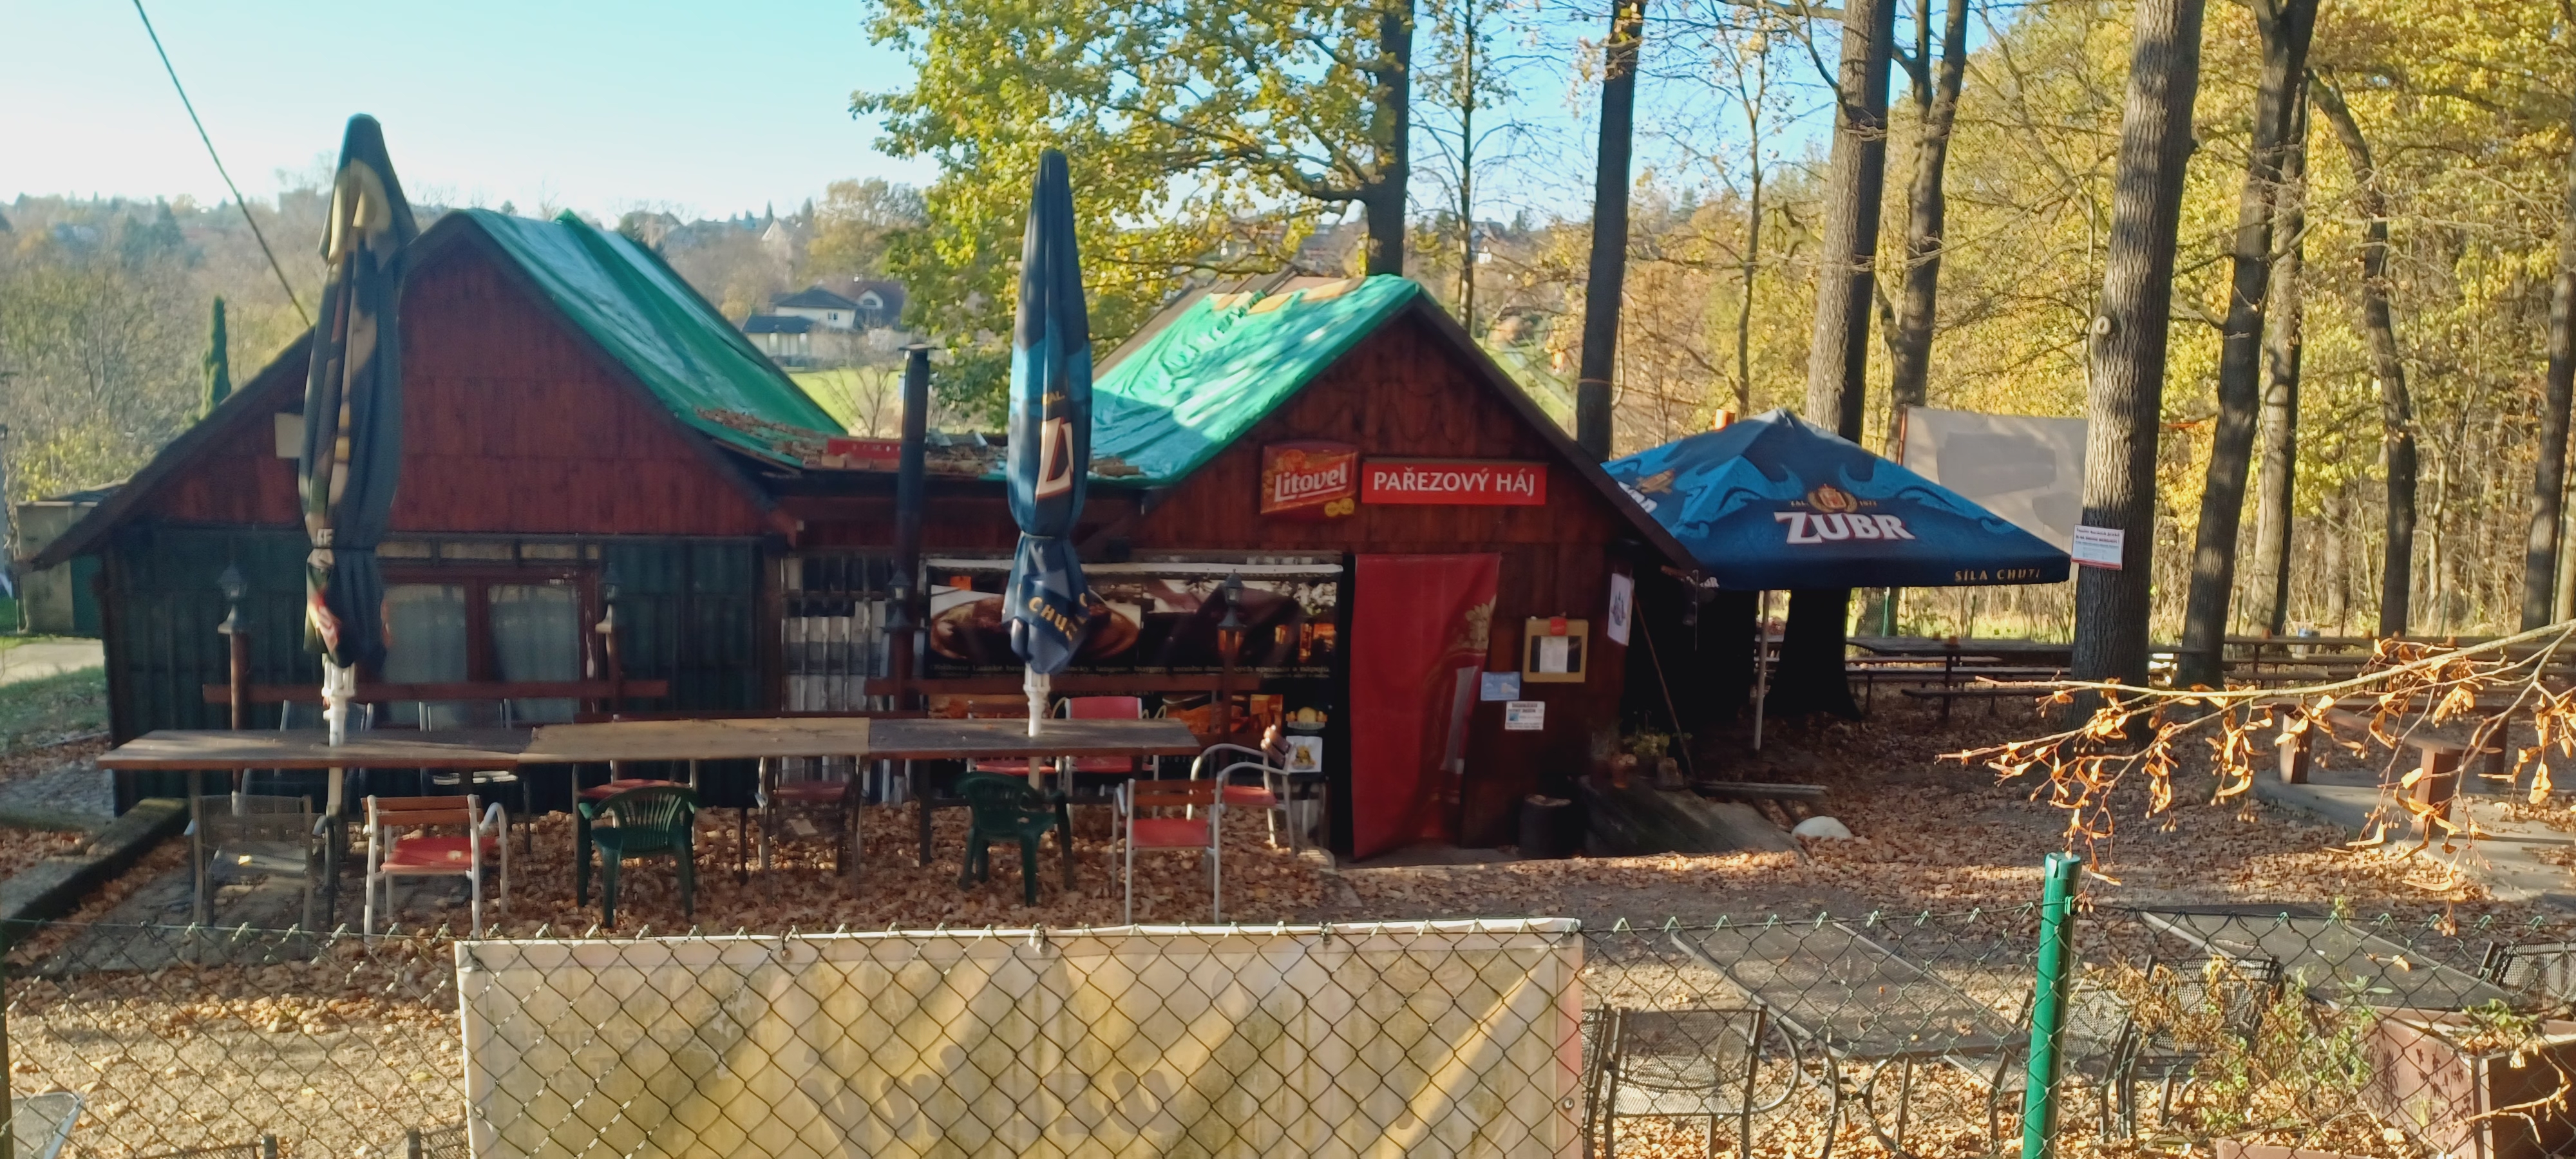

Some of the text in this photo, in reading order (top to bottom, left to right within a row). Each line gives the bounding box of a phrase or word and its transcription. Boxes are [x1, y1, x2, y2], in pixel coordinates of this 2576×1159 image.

[1274, 462, 1347, 502] Litovel
[1373, 466, 1535, 496] PAŘEZOVÝ HÁJ
[1774, 511, 1916, 545] ZUBR
[1955, 568, 1988, 582] SÍLA
